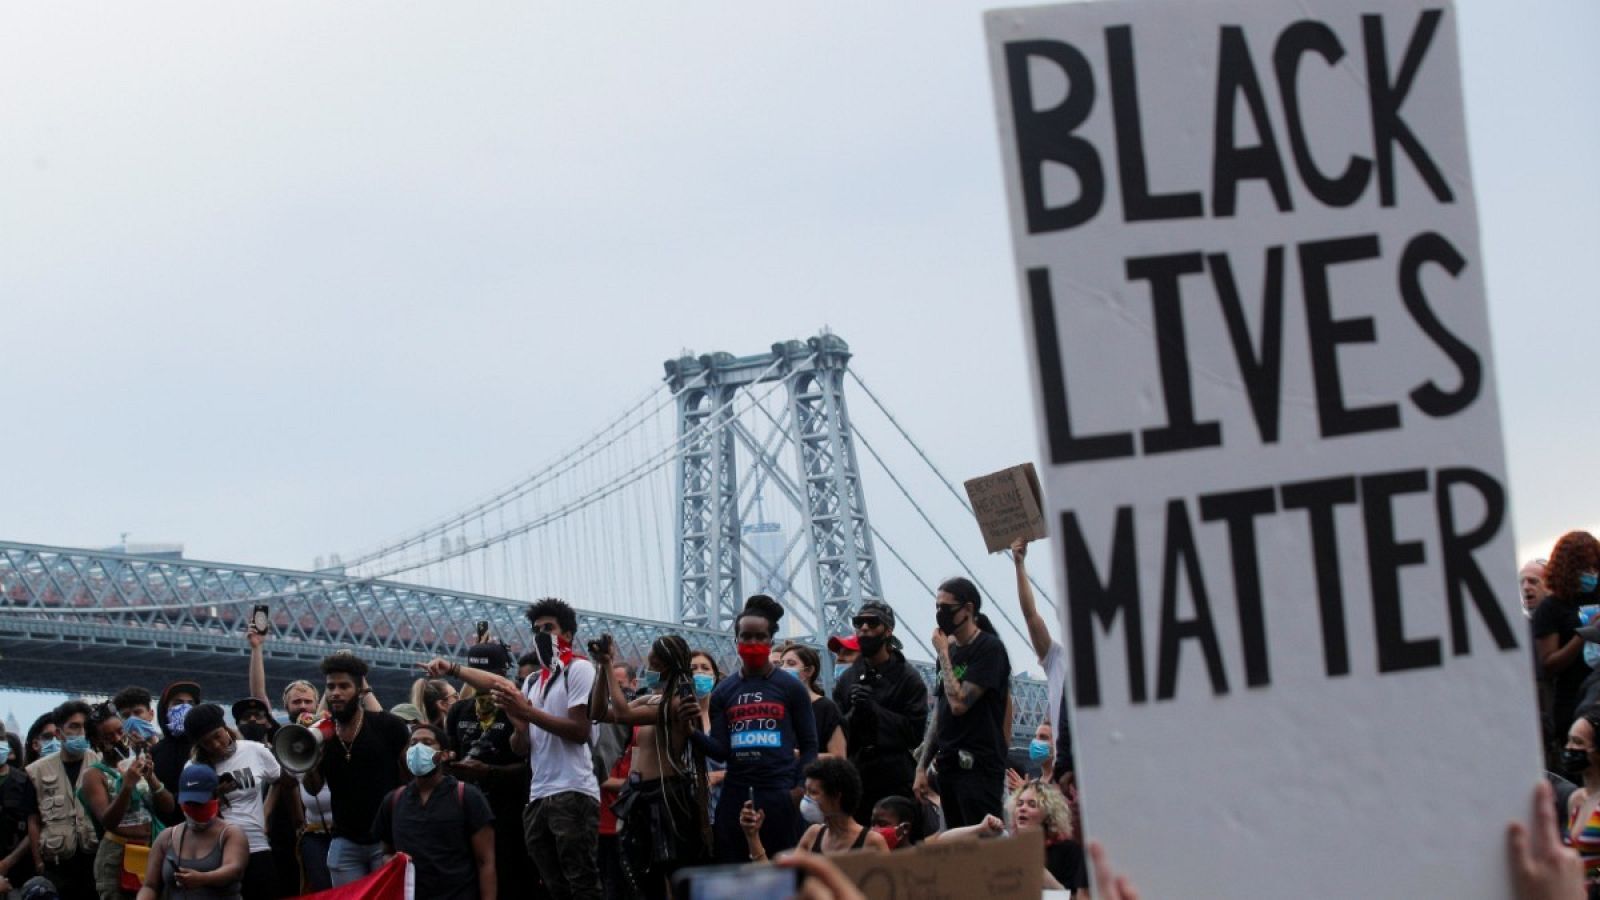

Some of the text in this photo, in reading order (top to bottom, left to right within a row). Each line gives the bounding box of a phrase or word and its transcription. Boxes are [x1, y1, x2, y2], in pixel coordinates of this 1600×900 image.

[1004, 9, 1455, 235] BLACK
[1027, 232, 1483, 466] LIVES
[738, 691, 763, 705] IT'S
[1060, 467, 1520, 709] MATTER
[757, 718, 777, 730] TO
